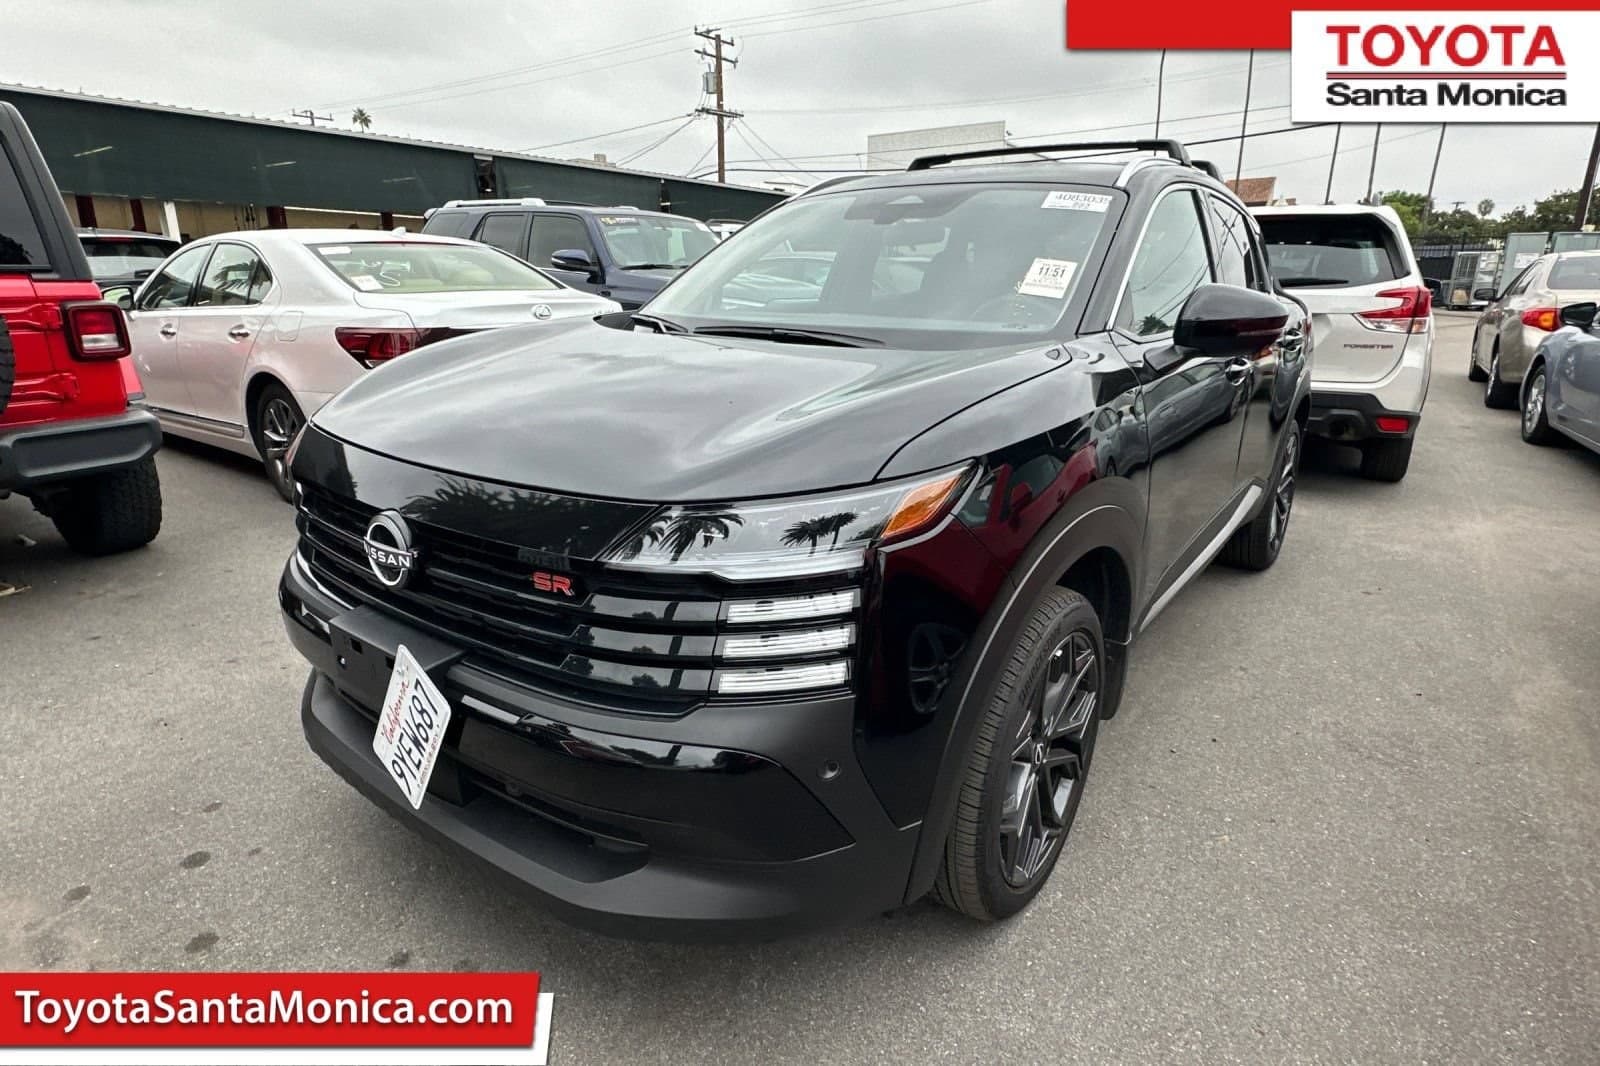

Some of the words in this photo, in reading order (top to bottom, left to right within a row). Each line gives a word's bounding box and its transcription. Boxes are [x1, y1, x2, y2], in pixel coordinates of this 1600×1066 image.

[363, 540, 411, 568] NISSAN
[533, 571, 573, 596] SR
[392, 678, 439, 796] 9YEW687
